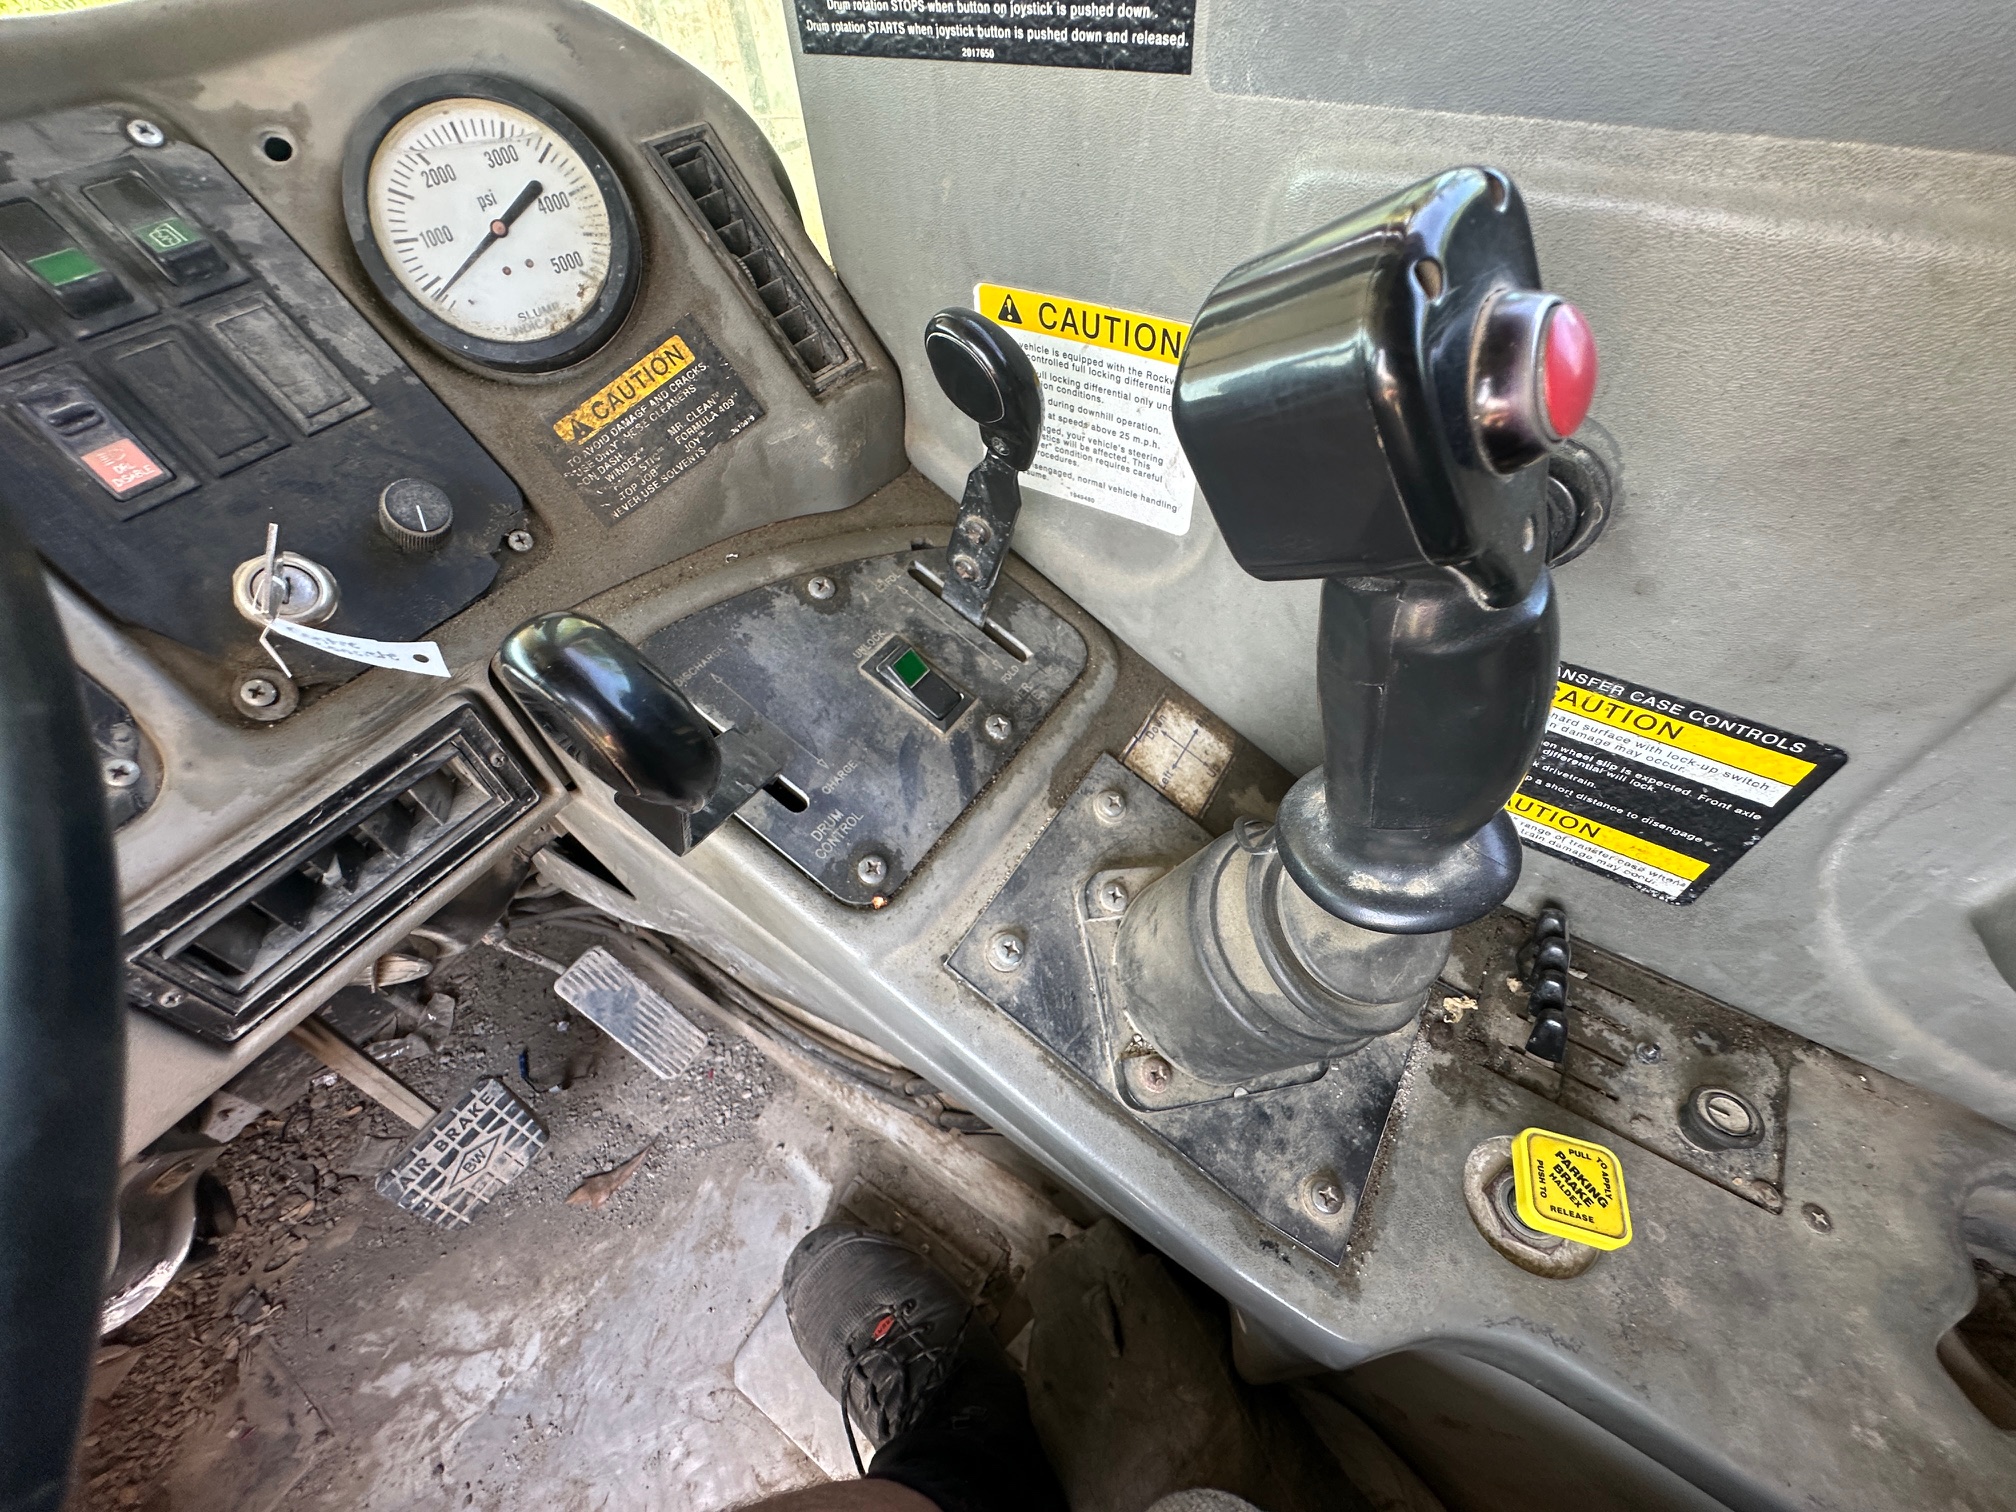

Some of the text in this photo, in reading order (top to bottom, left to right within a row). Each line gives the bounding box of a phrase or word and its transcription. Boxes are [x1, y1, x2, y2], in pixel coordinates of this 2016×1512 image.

[827, 0, 851, 11] Drum
[853, 0, 889, 12] rotation
[892, 0, 924, 12] STOPS
[928, 1, 954, 13] when
[957, 2, 990, 13] button
[994, 5, 1007, 14] on
[1010, 3, 1053, 18] joystick
[1057, 3, 1067, 15] is
[1070, 3, 1114, 18] pushed
[806, 19, 1189, 47] Drum rotation STARTS when joystick button is pushed down and released.
[961, 47, 994, 58] 2017650
[483, 144, 519, 168] 3000
[421, 164, 457, 188] 2000
[476, 189, 497, 212] psi
[538, 191, 570, 214] 4000
[419, 225, 454, 249] 1000
[550, 251, 584, 274] 5000
[518, 301, 560, 322] SLUMP
[1038, 302, 1182, 359] CAUTION
[1019, 342, 1049, 355] vehicle
[1052, 348, 1060, 357] is
[1062, 352, 1104, 367] equipped
[1107, 362, 1125, 373] with
[1128, 366, 1143, 377] the
[1027, 353, 1069, 370] controlled
[1072, 364, 1086, 374] full
[1089, 366, 1121, 384] locking
[592, 344, 685, 419] CAUTION
[1050, 373, 1081, 389] locking
[1084, 382, 1131, 401] differential
[1134, 395, 1154, 409] only
[1056, 386, 1104, 405] conditions.
[567, 455, 581, 468] TO
[582, 434, 611, 458] AVOID
[649, 390, 669, 407] AND
[576, 459, 595, 477] USE
[595, 440, 618, 463] ONLY
[649, 384, 697, 422] CLEANERS
[674, 411, 719, 445] FORMULA
[1048, 398, 1162, 435] during downhill operation.
[1048, 412, 1161, 450] at speeds above 25 m.p.h.
[1037, 449, 1080, 467] rocedures.
[1054, 445, 1093, 462] condition
[1095, 457, 1130, 474] requires
[1133, 469, 1163, 483] careful
[1063, 439, 1077, 449] will
[1080, 443, 1090, 452] be
[1092, 447, 1130, 464] affected.
[1133, 458, 1151, 470] This
[1066, 431, 1164, 467] your vehicle's steering
[582, 472, 600, 485] ON
[640, 480, 661, 498] USE
[662, 447, 706, 482] SOLVENTS
[619, 482, 638, 501] TOP
[1077, 476, 1106, 490] normal
[1108, 484, 1138, 499] vehicle
[1140, 494, 1178, 513] handling
[852, 629, 887, 659] UNLOCK
[673, 644, 728, 687] DISCHARGE
[1001, 665, 1019, 685] FOLD
[1145, 714, 1167, 740] Down
[1558, 667, 1806, 753] NSFER CASE CONTROLS
[1561, 722, 1611, 747] damage
[1614, 744, 1643, 758] may
[1645, 755, 1685, 773] occur.
[1583, 724, 1631, 744] surface
[1636, 741, 1663, 755] with
[1667, 750, 1718, 778] lock-up
[1722, 771, 1770, 791] switch
[821, 759, 858, 795] CHARGE
[1542, 749, 1604, 775] differential
[1606, 769, 1626, 783] will
[1629, 778, 1657, 793] lock.
[1542, 763, 1597, 789] drivetrain.
[1561, 745, 1594, 762] wheel
[1596, 758, 1618, 771] slip
[1621, 766, 1632, 775] is
[1634, 773, 1692, 797] expected.
[1697, 794, 1732, 811] Front
[1734, 807, 1762, 820] axle
[810, 808, 845, 842] DRUM
[1534, 777, 1543, 785] a
[1545, 781, 1574, 796] short
[1576, 793, 1624, 814] distance
[1626, 811, 1639, 820] to
[1641, 816, 1703, 843] disengage
[814, 812, 864, 859] CONTROL
[1519, 821, 1551, 836] range
[1555, 833, 1567, 844] of
[1549, 839, 1592, 860] damage
[400, 1091, 496, 1190] AIR BRAKE
[462, 1149, 486, 1174] BW
[1568, 1148, 1613, 1200] PULL TO APPLY
[1536, 1159, 1595, 1224] PUSH TO RELEASE
[1549, 1173, 1582, 1208] HALDEX
[1552, 1163, 1595, 1208] BRAKE
[1554, 1150, 1609, 1209] PARKING
